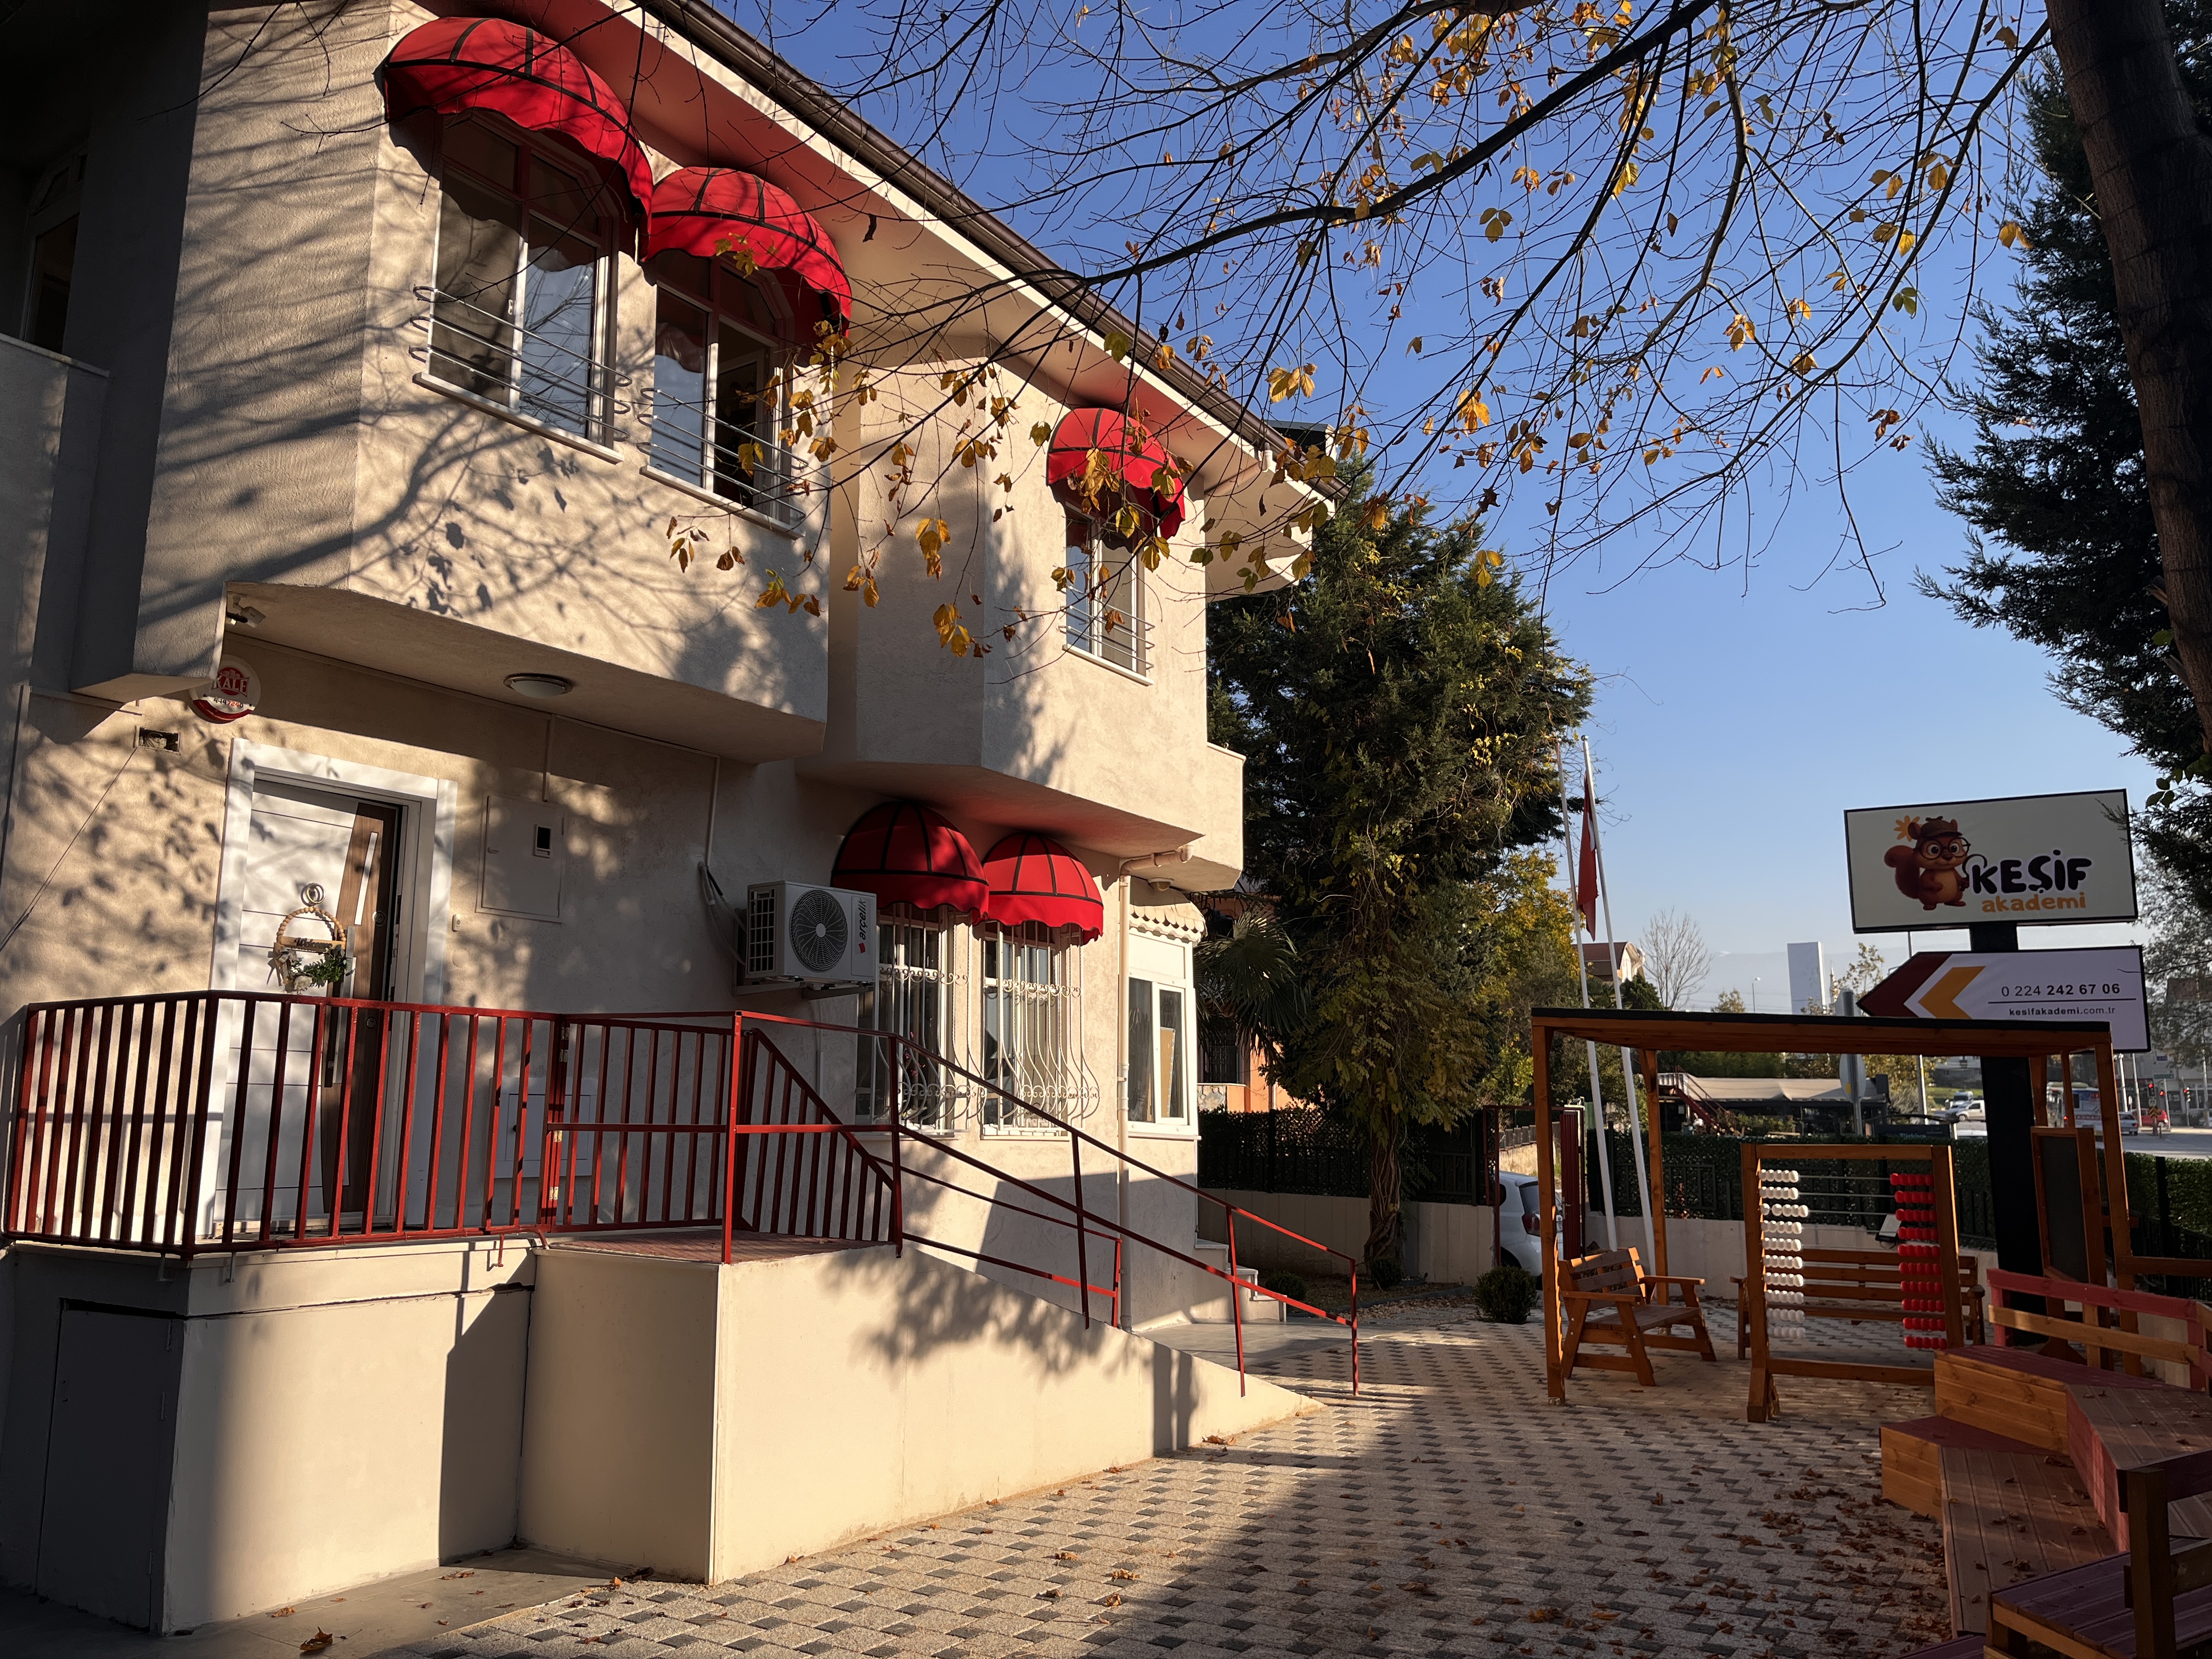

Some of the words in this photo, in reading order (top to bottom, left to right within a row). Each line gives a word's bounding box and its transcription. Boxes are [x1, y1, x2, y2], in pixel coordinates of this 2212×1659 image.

[213, 675, 248, 695] KALE
[1972, 849, 2092, 894] KEŞİF
[1982, 891, 2086, 912] akademi
[858, 898, 867, 940] arçelik
[2001, 986, 2010, 997] 0
[2015, 985, 2041, 996] 224
[2047, 984, 2074, 996] 242
[2079, 984, 2096, 995] 67
[2102, 983, 2120, 994] 06
[2009, 1006, 2115, 1015] kesifakademi.com.tr
